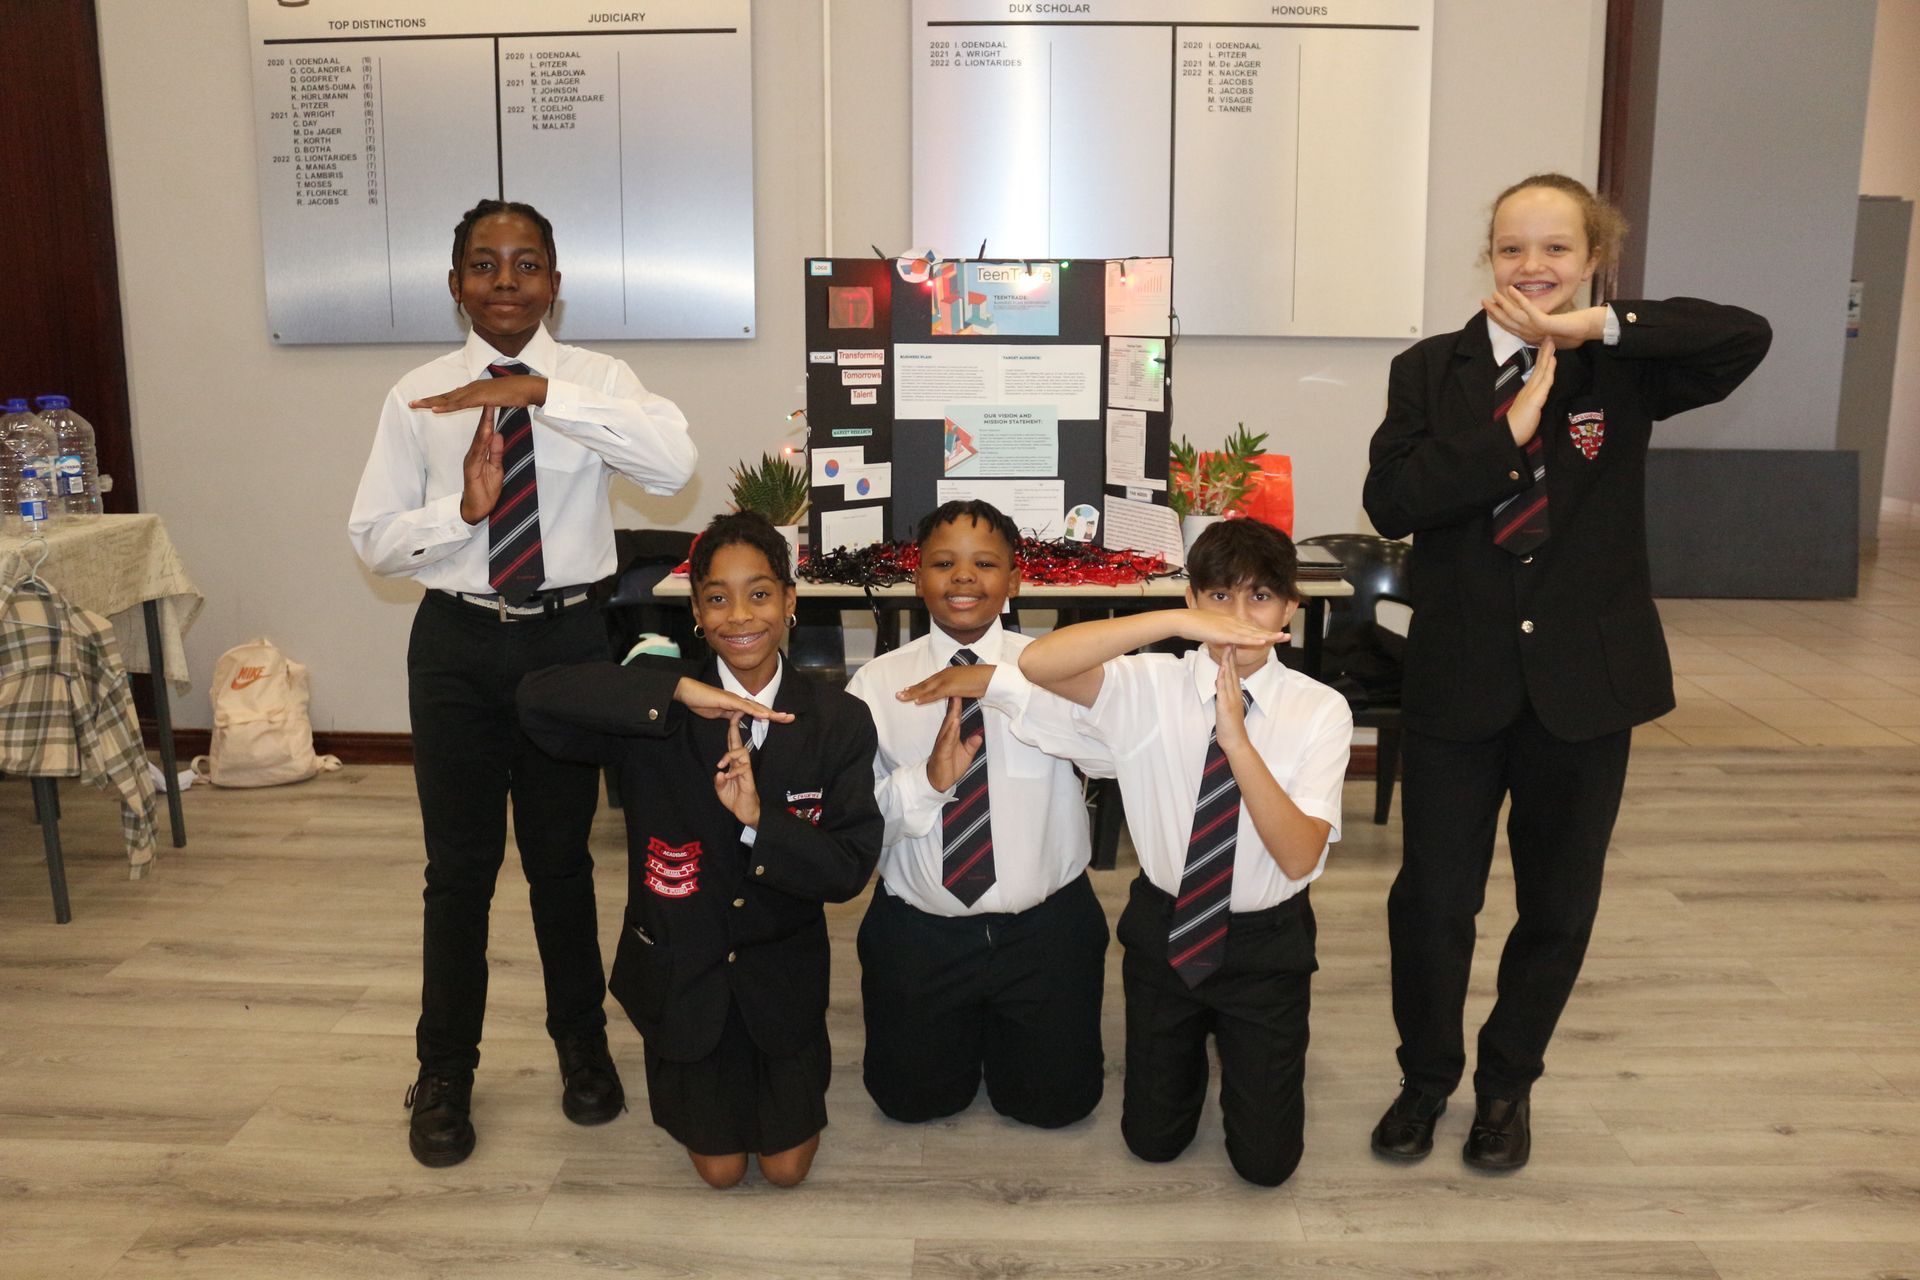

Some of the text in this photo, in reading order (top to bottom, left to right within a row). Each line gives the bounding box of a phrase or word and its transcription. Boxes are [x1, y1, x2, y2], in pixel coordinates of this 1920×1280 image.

[1010, 4, 1091, 13] DUX SCHOLAR
[1272, 6, 1328, 16] HONOURS
[588, 13, 646, 23] JUDICIARY
[328, 19, 426, 30] TOP DISTINCTIONS
[301, 66, 352, 74] COLANDREA
[300, 75, 339, 83] GODFREY
[541, 95, 605, 103] KADYAMADARE
[1219, 105, 1252, 113] TANNER
[365, 119, 374, 127] (7)
[366, 136, 375, 144] (7)
[305, 154, 357, 162] LIONTARIDES
[367, 162, 376, 170] (7)
[368, 171, 377, 179] (7)
[307, 189, 349, 197] FLORENCE
[978, 268, 1051, 282] TeenTe
[839, 352, 883, 361] Transforming
[238, 666, 266, 680] NIKE
